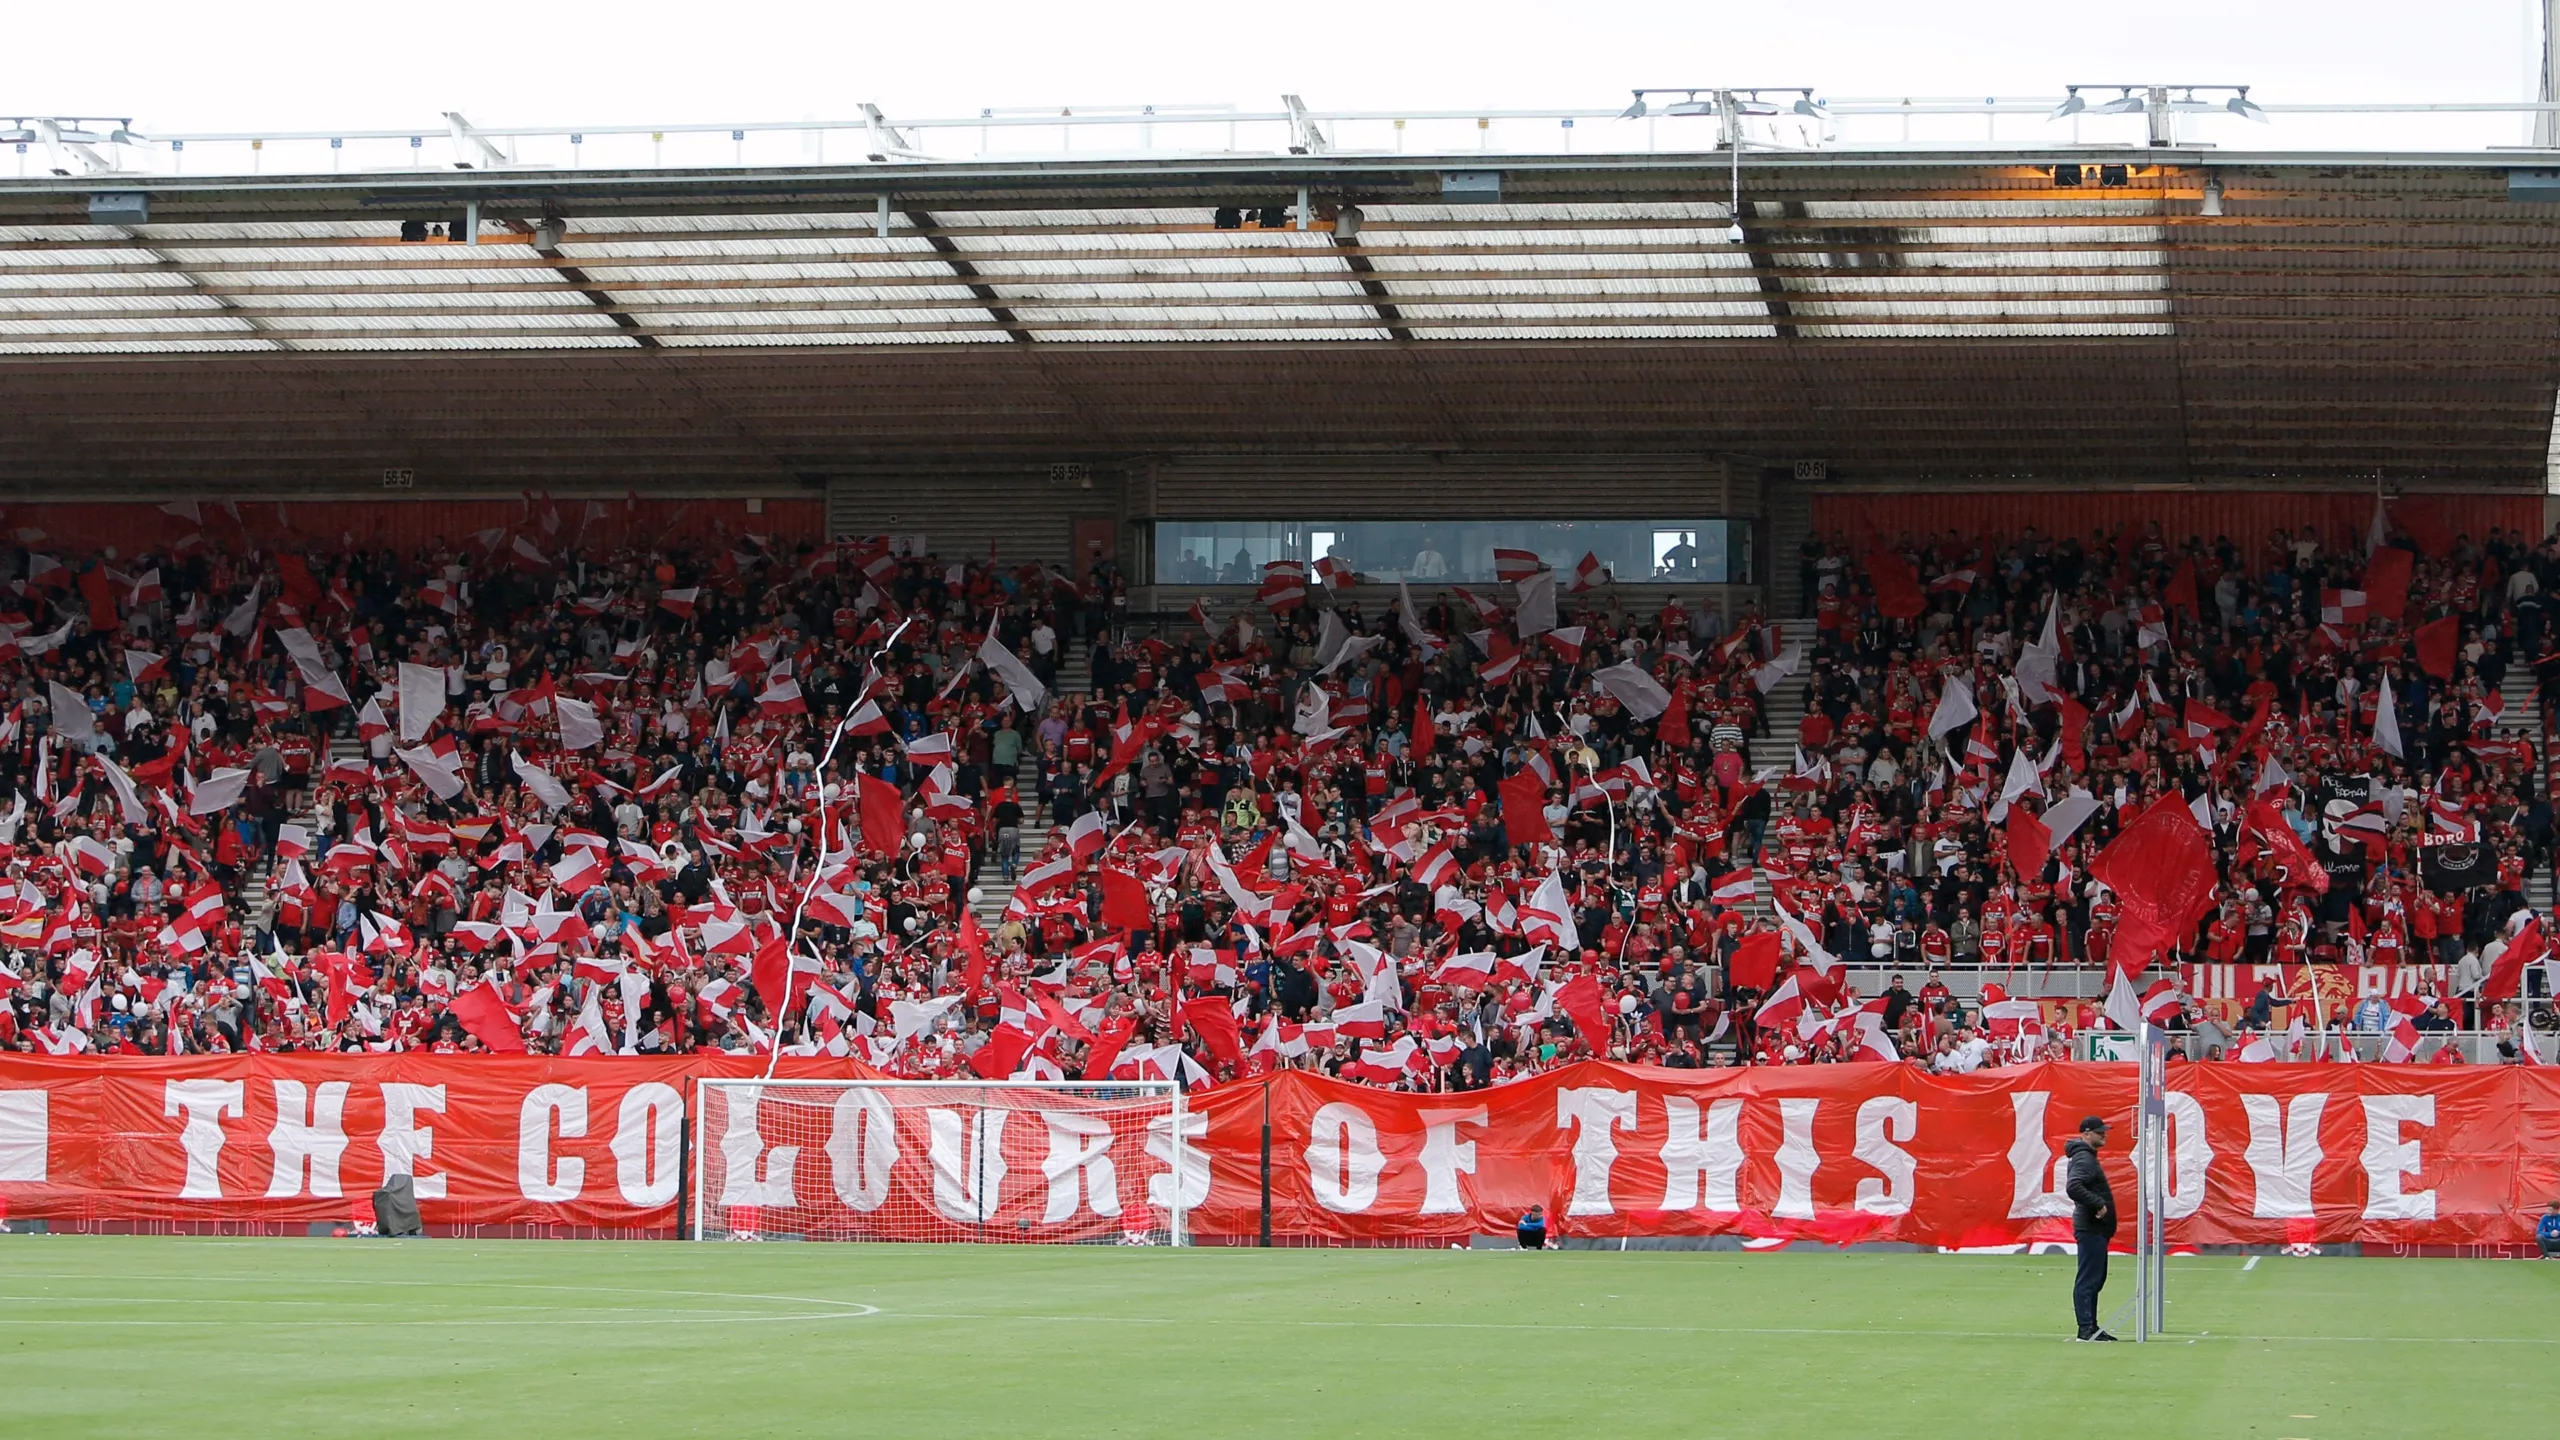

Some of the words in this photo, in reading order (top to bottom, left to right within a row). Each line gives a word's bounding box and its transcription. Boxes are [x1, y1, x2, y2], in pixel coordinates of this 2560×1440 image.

[384, 470, 412, 485] 56-57
[1052, 464, 1080, 480] 58-59
[2424, 831, 2464, 846] BORO
[164, 1079, 448, 1199] THE
[518, 1082, 1212, 1224] COLOURS
[1303, 1103, 1489, 1215] OF
[1557, 1087, 1917, 1221] THIS
[2006, 1091, 2437, 1220] LOVE
